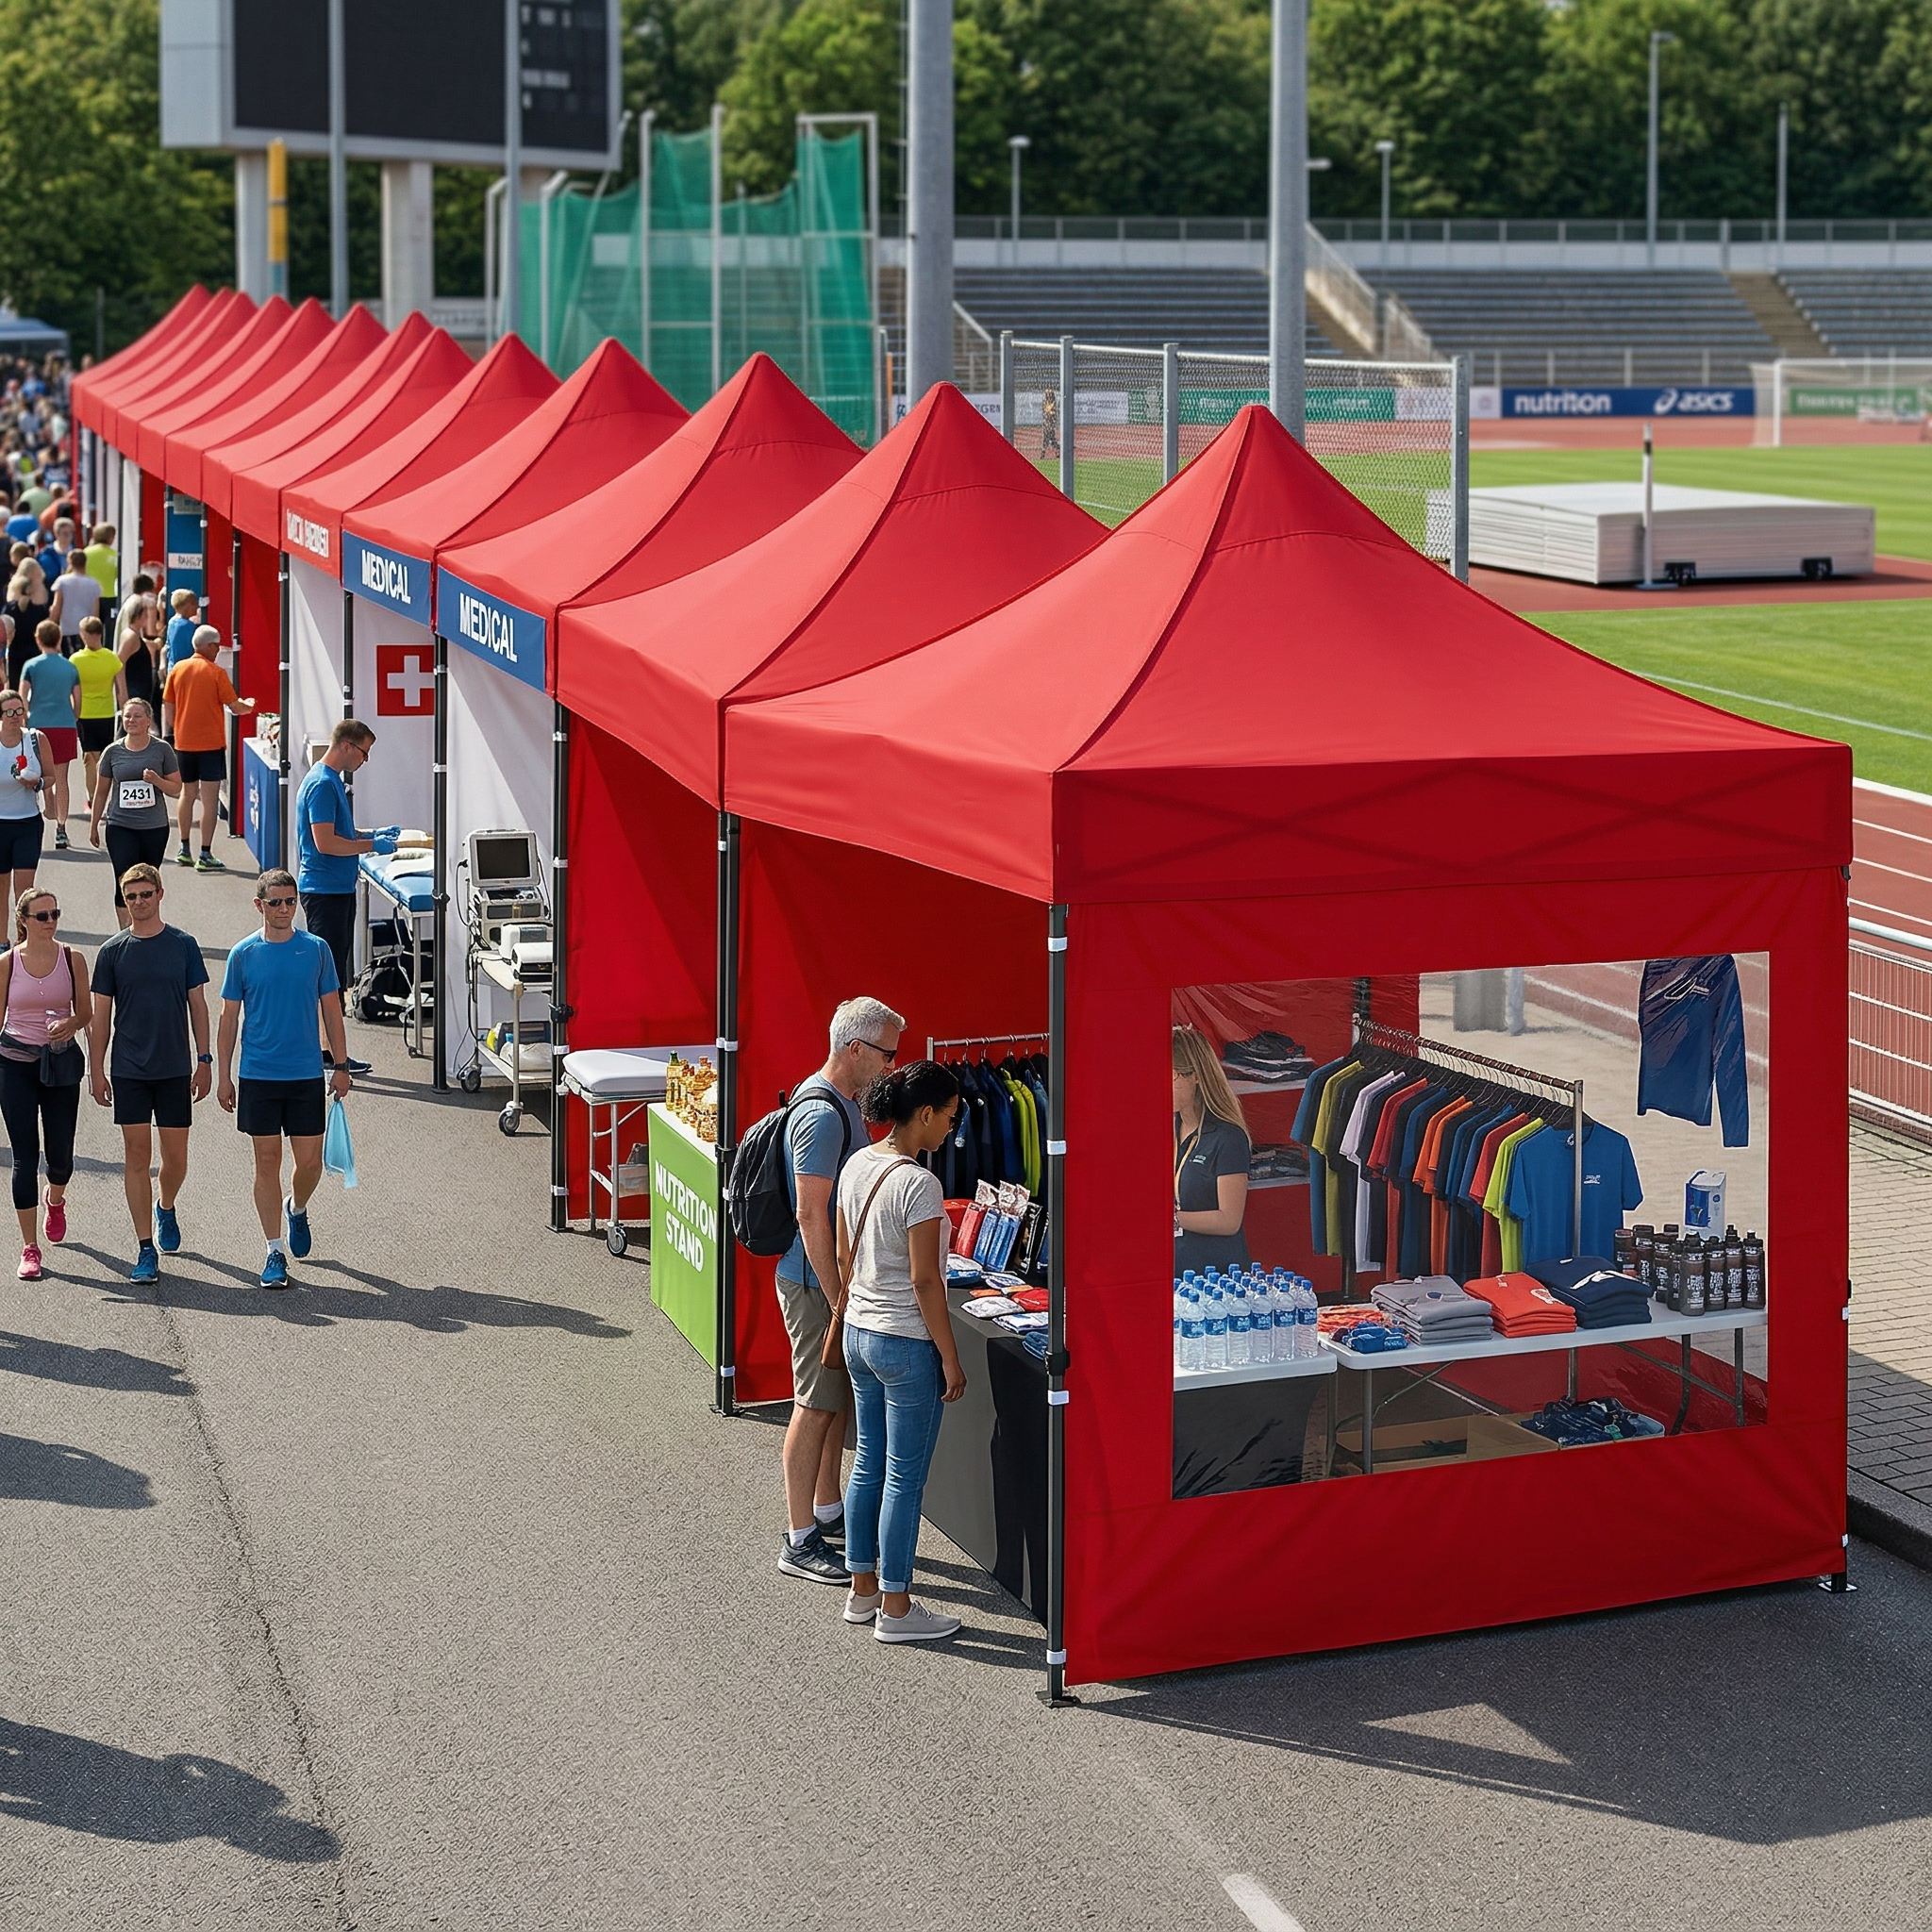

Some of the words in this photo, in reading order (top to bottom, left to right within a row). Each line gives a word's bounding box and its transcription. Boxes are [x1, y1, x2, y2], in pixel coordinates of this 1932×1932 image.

[361, 549, 411, 605] MEDICAL
[459, 592, 518, 663] MEDICAL
[123, 788, 151, 800] 2431
[655, 1158, 717, 1244] NUTRITION
[666, 1209, 704, 1273] STAND
